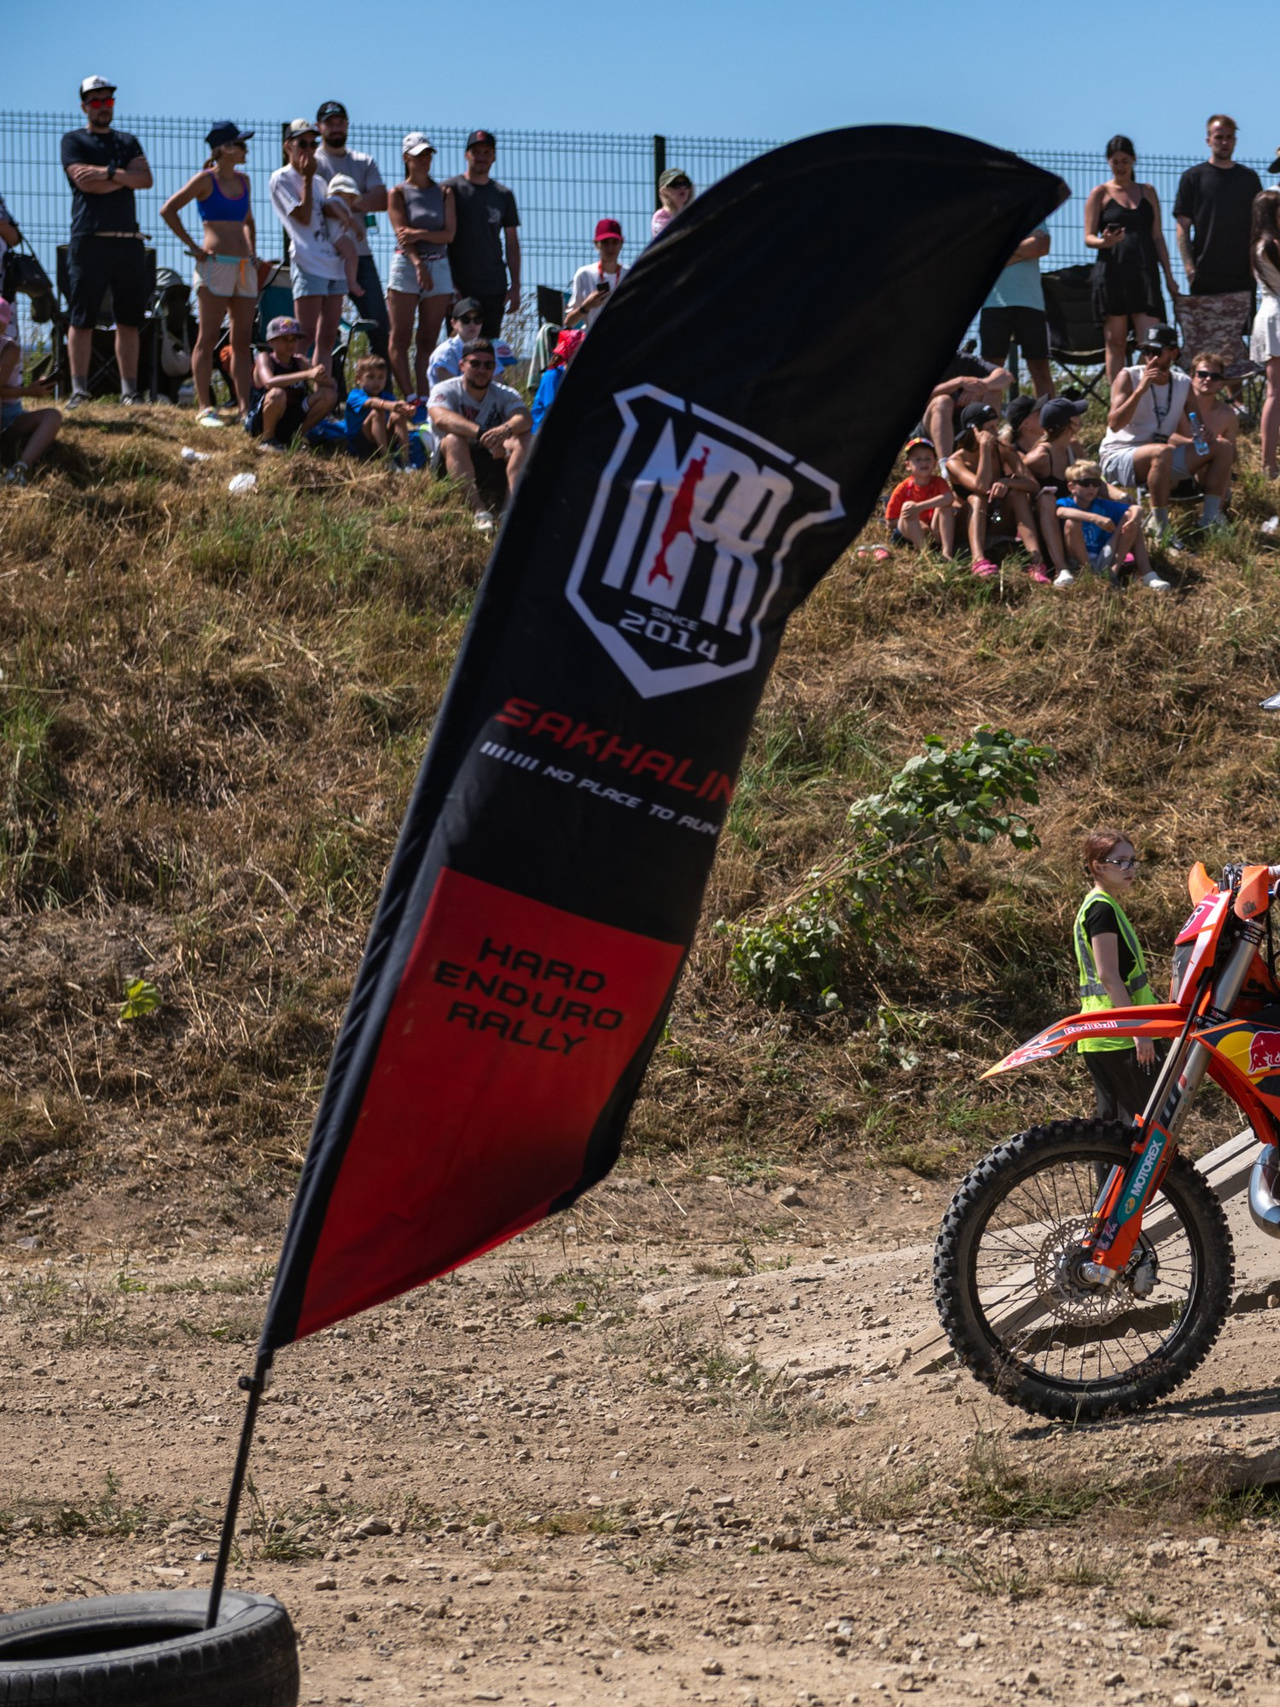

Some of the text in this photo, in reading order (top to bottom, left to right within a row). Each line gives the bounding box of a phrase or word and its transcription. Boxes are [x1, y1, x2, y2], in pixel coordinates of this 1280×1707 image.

[618, 609, 719, 661] 2014
[650, 606, 700, 631] SINCE
[494, 697, 738, 805] SAKHALIN
[542, 765, 720, 836] NO PLACE TO RUN
[477, 936, 606, 994] HARD
[433, 960, 624, 1031] ENDURO
[446, 1001, 588, 1056] RALLY
[1063, 1020, 1118, 1035] Red Bull
[1130, 1139, 1164, 1197] MOTOREX
